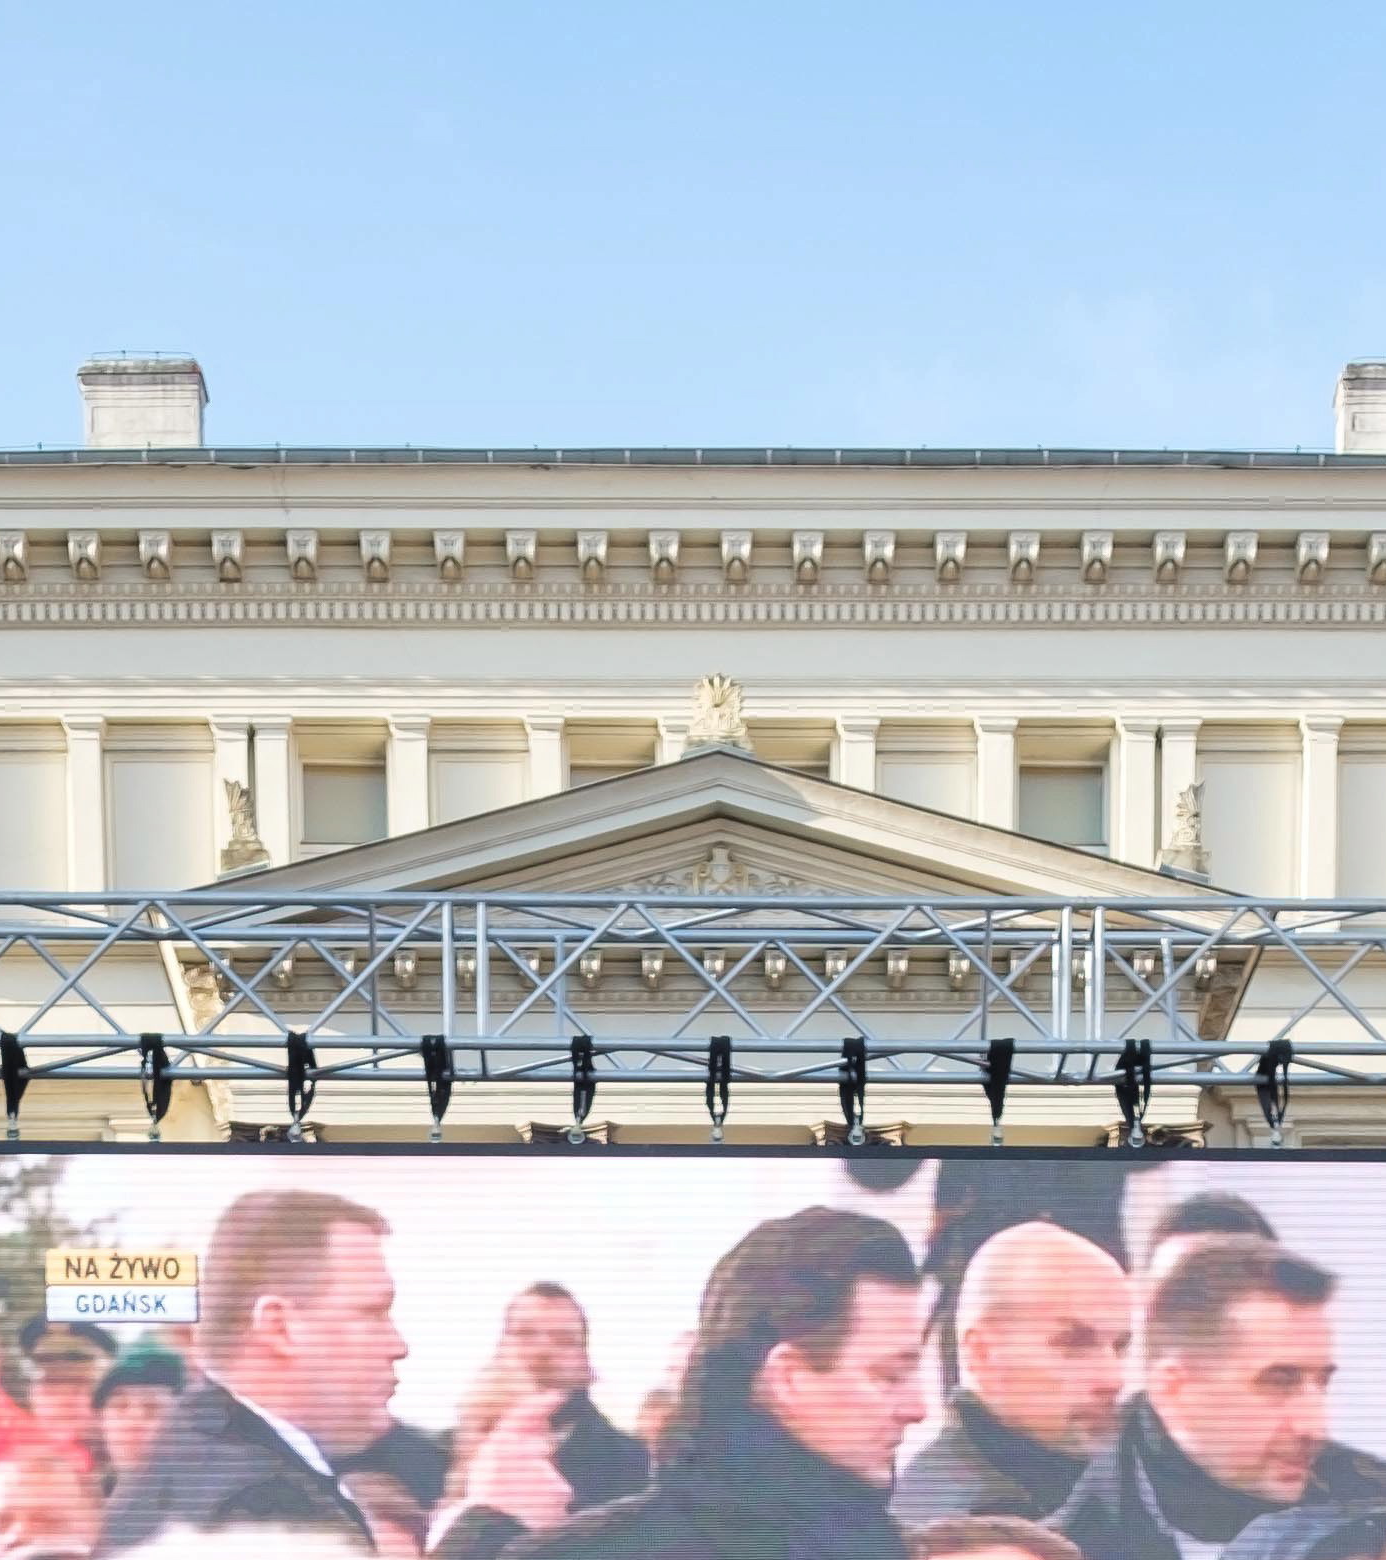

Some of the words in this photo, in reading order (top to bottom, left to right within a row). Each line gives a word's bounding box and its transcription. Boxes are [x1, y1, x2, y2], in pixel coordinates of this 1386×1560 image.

[65, 1256, 100, 1279] NA
[109, 1252, 180, 1280] ŻYWO
[75, 1290, 167, 1313] GDAŃSK
